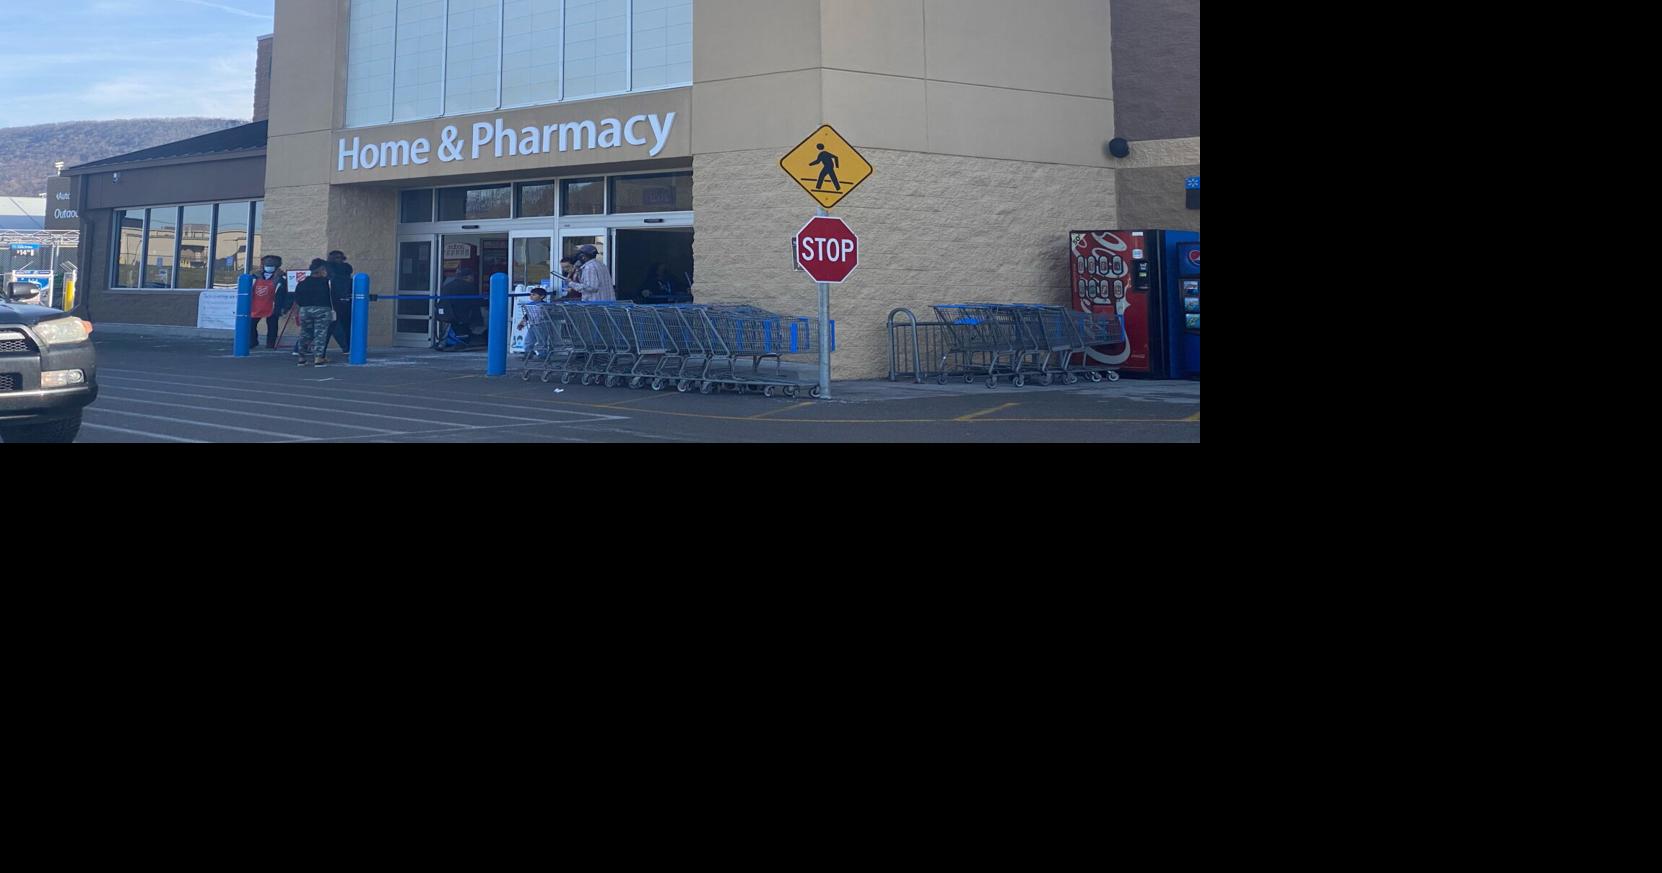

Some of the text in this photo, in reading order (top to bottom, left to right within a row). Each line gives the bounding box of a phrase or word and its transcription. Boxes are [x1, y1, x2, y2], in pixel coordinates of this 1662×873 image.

[337, 111, 676, 171] Home & Pharmacy
[801, 236, 854, 262] STOP
